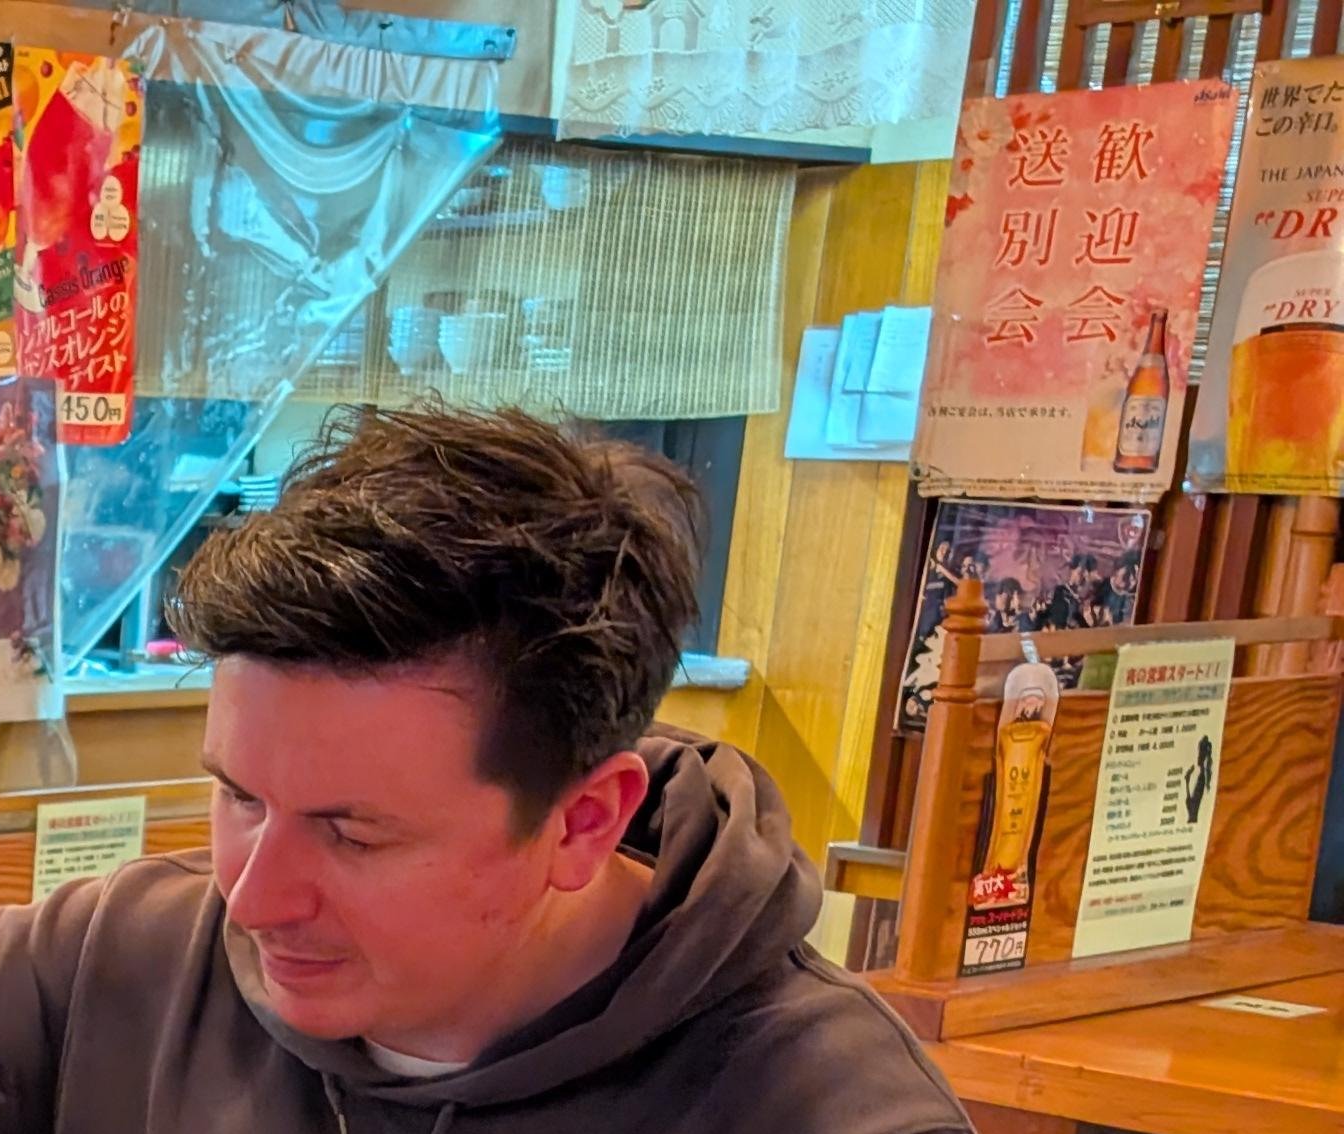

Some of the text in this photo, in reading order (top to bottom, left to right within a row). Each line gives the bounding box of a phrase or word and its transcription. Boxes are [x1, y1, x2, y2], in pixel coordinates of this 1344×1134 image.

[985, 128, 1069, 344] 送別会
[1066, 122, 1154, 343] 歓迎会
[1260, 168, 1289, 183] THE
[976, 936, 1024, 964] 770円
